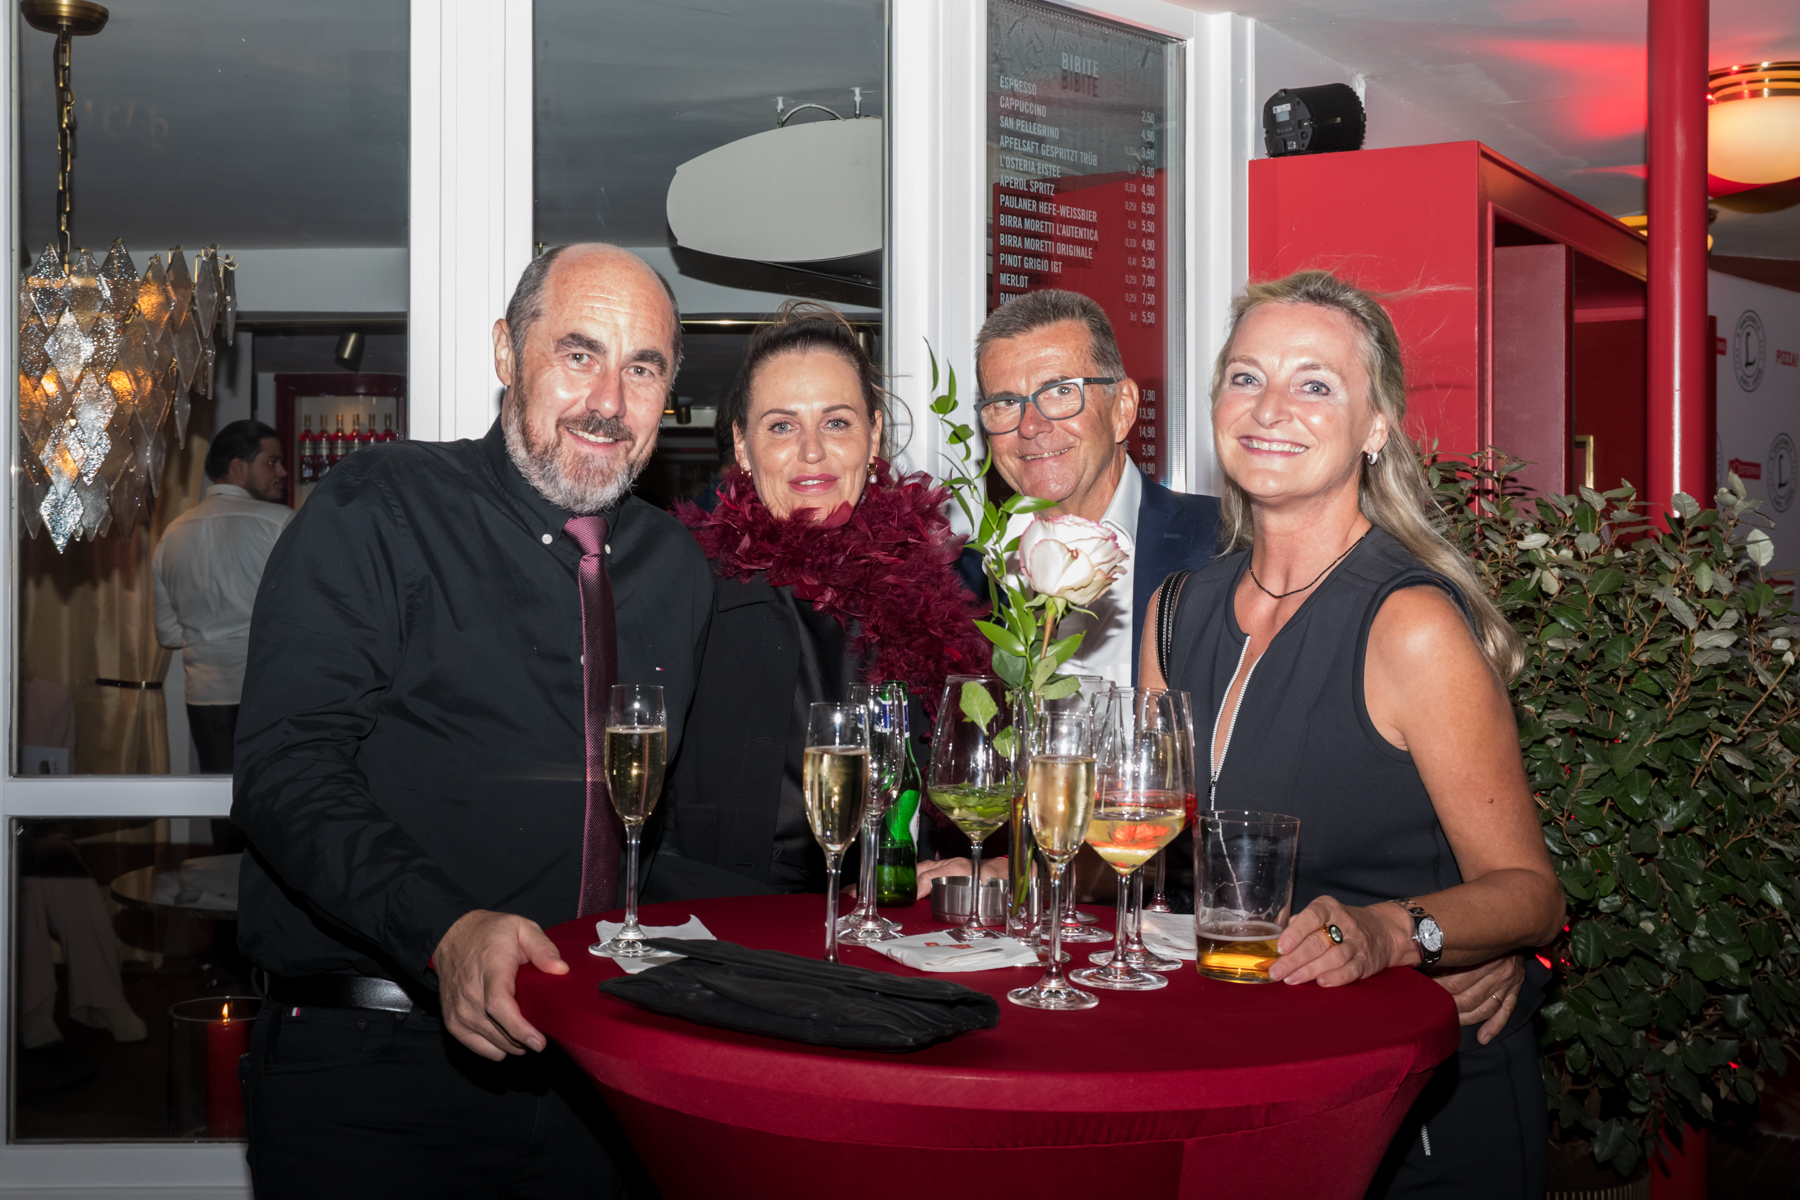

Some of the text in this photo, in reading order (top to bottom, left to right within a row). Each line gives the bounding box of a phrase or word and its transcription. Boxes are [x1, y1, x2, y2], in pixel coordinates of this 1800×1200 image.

[1062, 52, 1099, 78] BIBITE
[1000, 75, 1155, 124] ESPRESSO 2,50
[1000, 95, 1155, 142] CAPPUCCINO 4,90
[1000, 115, 1014, 130] SAN
[1016, 118, 1060, 139] PELLEGRINO
[1141, 147, 1155, 160] 3,50
[1000, 134, 1039, 154] APFELSAFT
[1041, 143, 1079, 162] GESPRITZT
[1080, 151, 1098, 167] TRÜB
[1141, 165, 1155, 178] 3,90
[1000, 155, 1036, 173] L'OSTERIA
[1038, 162, 1061, 178] EISTEE
[1141, 183, 1155, 197] 4,90
[1000, 174, 1028, 192] APEROL
[1029, 180, 1055, 196] SPRITZ
[1141, 202, 1155, 215] 6,50
[1000, 194, 1037, 212] PAULANER
[1039, 201, 1098, 223] HEFE-WEISSBIER
[1141, 220, 1155, 233] 5,50
[1000, 213, 1022, 230] BIRRA
[1024, 218, 1055, 234] MORETTI
[1057, 223, 1099, 242] L'AUTENTICA
[1141, 238, 1155, 251] 4,90
[1000, 233, 1022, 249] BIRRA
[1024, 237, 1055, 254] MORETTI
[1057, 242, 1093, 260] ORIGINALE
[1141, 256, 1155, 270] 5,30
[1000, 252, 1022, 268] PINOT
[1024, 256, 1048, 272] GRIGIO
[1051, 260, 1063, 274] IGT
[1142, 274, 1155, 288] 7,90
[1000, 272, 1029, 289] MERLOT
[1142, 293, 1155, 306] 7,50
[1142, 311, 1155, 324] 5,50
[1139, 407, 1155, 420] 13,90
[1142, 389, 1155, 402] 7,90
[1139, 426, 1155, 439] 14,90
[1142, 444, 1155, 457] 5,90
[1139, 463, 1155, 475] 10,90
